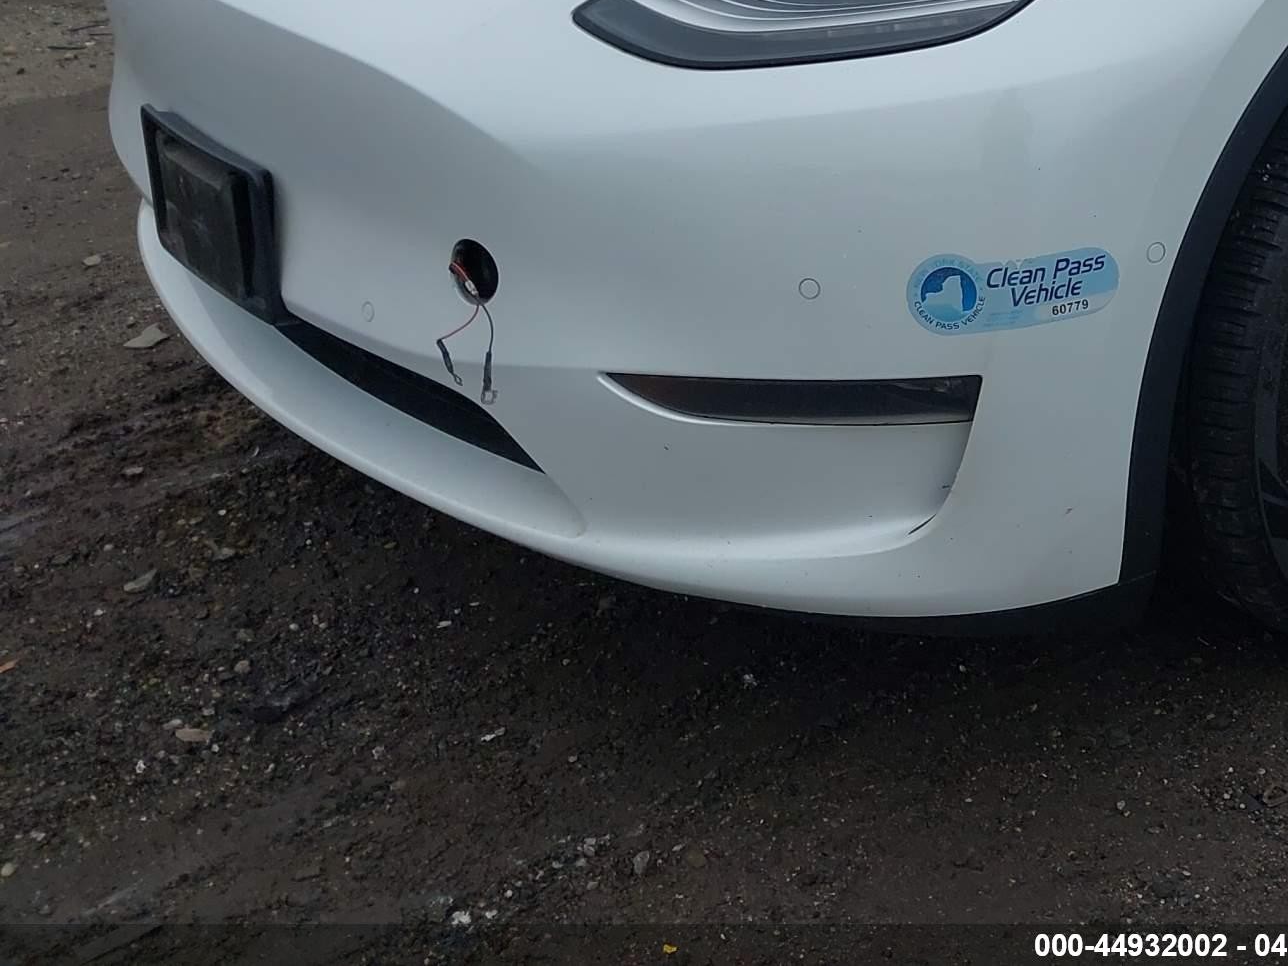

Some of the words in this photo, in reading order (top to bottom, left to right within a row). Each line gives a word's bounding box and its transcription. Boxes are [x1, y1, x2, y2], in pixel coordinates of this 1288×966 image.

[987, 267, 1046, 288] Clean
[1053, 254, 1106, 280] Pass
[1011, 278, 1083, 307] Vehicle
[1052, 299, 1089, 316] 60779
[914, 301, 934, 325] CLEAN
[935, 321, 960, 330] PASS
[961, 296, 986, 326] VEHICLE
